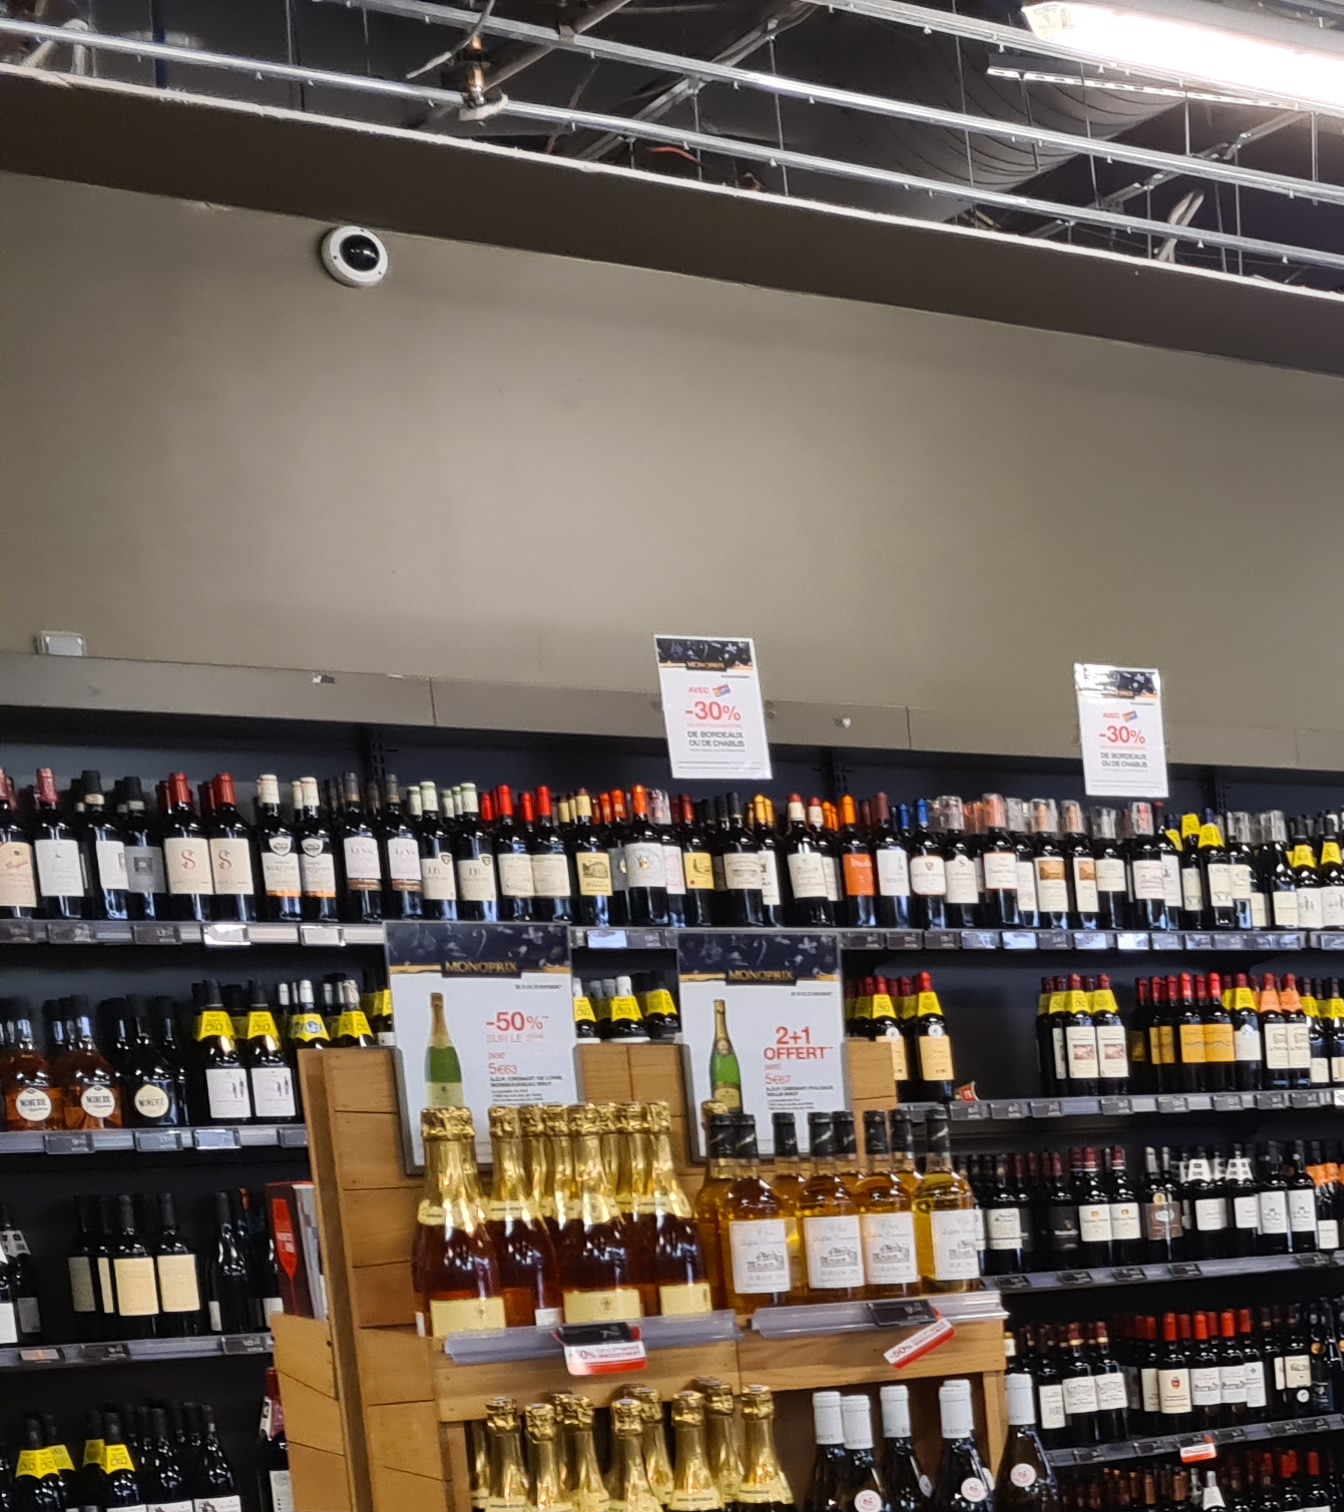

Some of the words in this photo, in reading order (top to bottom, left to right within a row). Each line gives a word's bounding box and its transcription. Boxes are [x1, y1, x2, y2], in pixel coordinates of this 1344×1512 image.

[685, 700, 741, 721] -30%
[1099, 725, 1146, 744] -30%
[445, 960, 518, 973] MONOPRIX
[727, 969, 793, 980] MONOPRIX
[775, 1026, 812, 1045] 2+1
[763, 1047, 827, 1060] OFFERT
